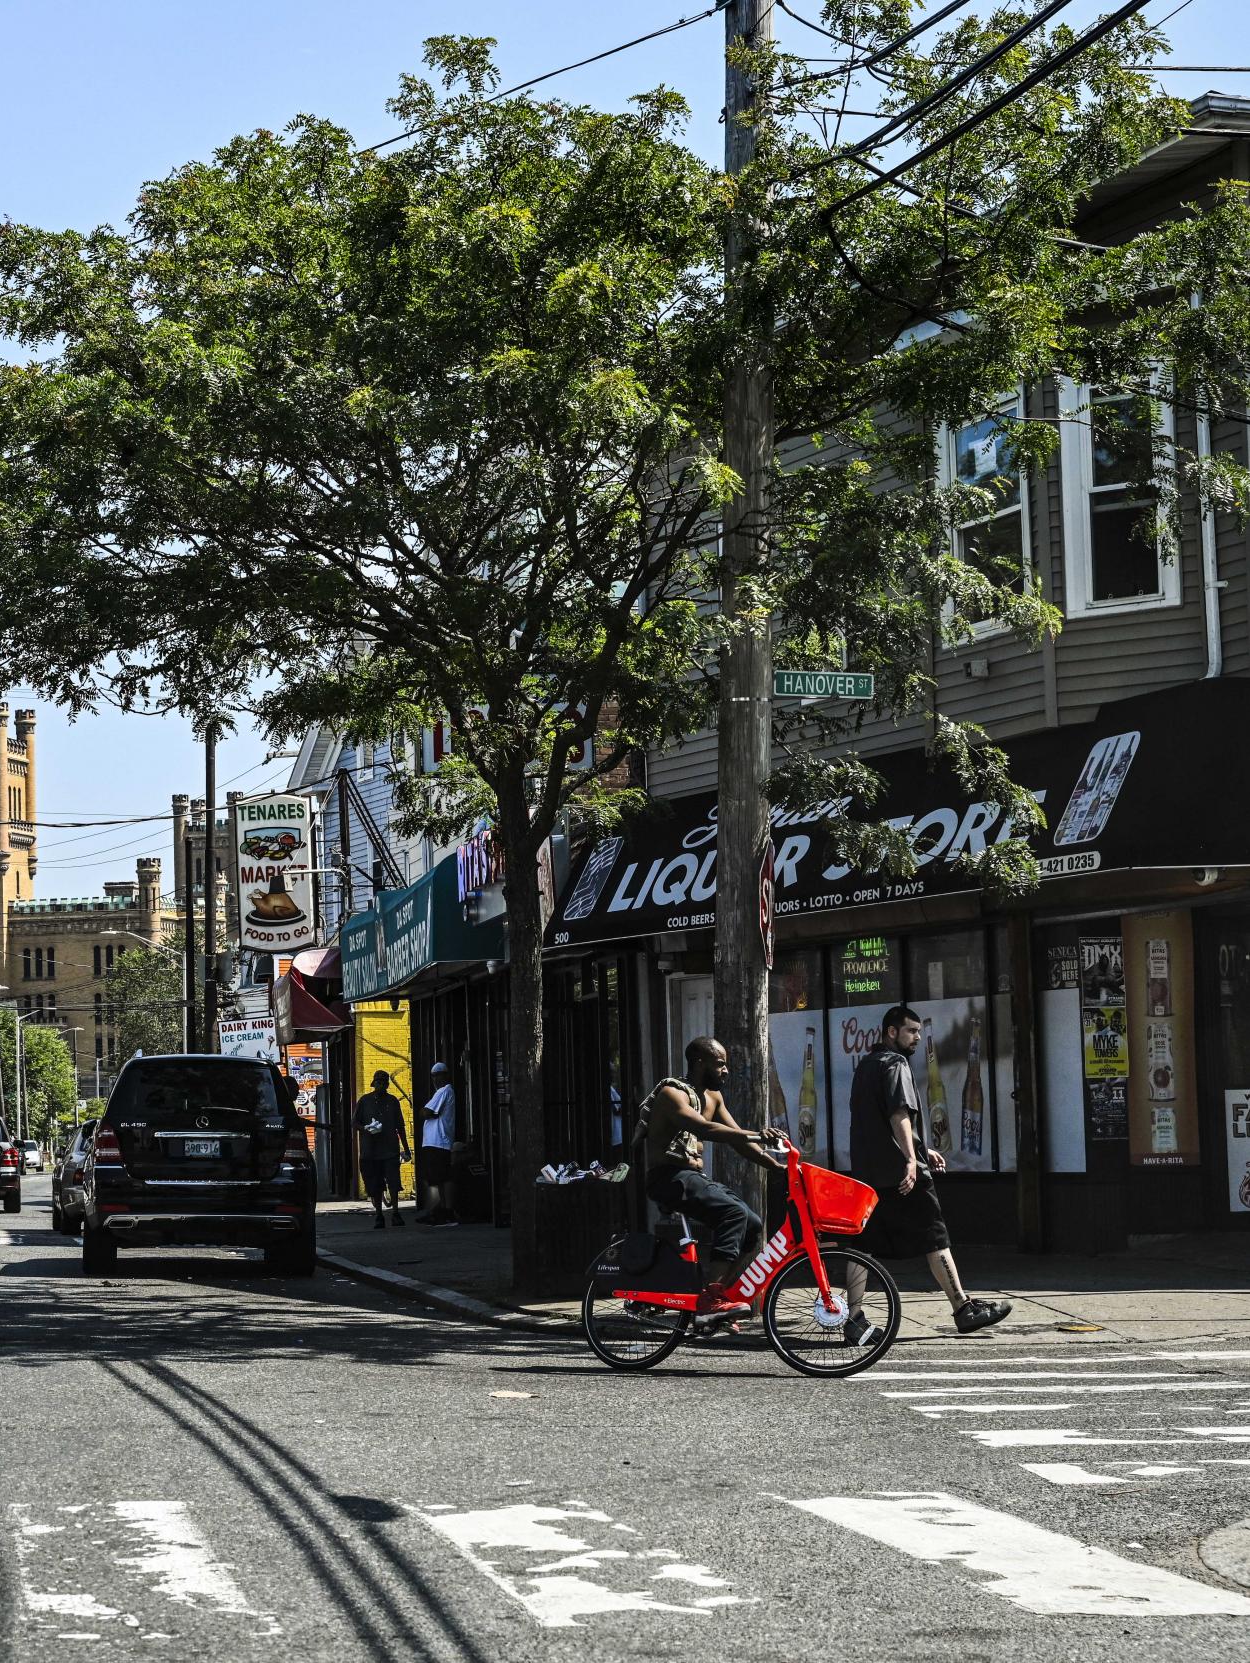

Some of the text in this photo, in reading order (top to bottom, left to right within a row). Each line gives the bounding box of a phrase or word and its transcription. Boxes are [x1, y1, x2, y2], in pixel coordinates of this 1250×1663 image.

[784, 675, 868, 695] HANOVER ST
[238, 804, 304, 821] TENARES
[1068, 853, 1094, 870] 0235
[607, 834, 810, 912] LIQUR
[809, 894, 842, 909] LOTTO
[854, 888, 880, 902] OPEN
[886, 886, 893, 898] 7
[896, 882, 924, 896] DAYS
[402, 900, 414, 925] SPOT
[667, 912, 715, 928] COLD BEERS
[244, 926, 309, 942] FOOD TO GO
[355, 930, 366, 950] SPOT
[554, 932, 569, 944] 500
[386, 920, 426, 986] BARBER SHOP
[1048, 946, 1077, 957] SENECA
[1082, 944, 1122, 971] DMX
[1062, 960, 1078, 970] SOLD
[1062, 970, 1078, 980] HERE
[845, 979, 880, 992] Heineken
[222, 1020, 274, 1032] DAIRY KING
[222, 1032, 264, 1043] ICE CREAM
[1093, 1034, 1118, 1048] MYKE
[1094, 1048, 1118, 1058] TOWERS
[1112, 1090, 1124, 1099] 11
[740, 1230, 787, 1298] JUMP
